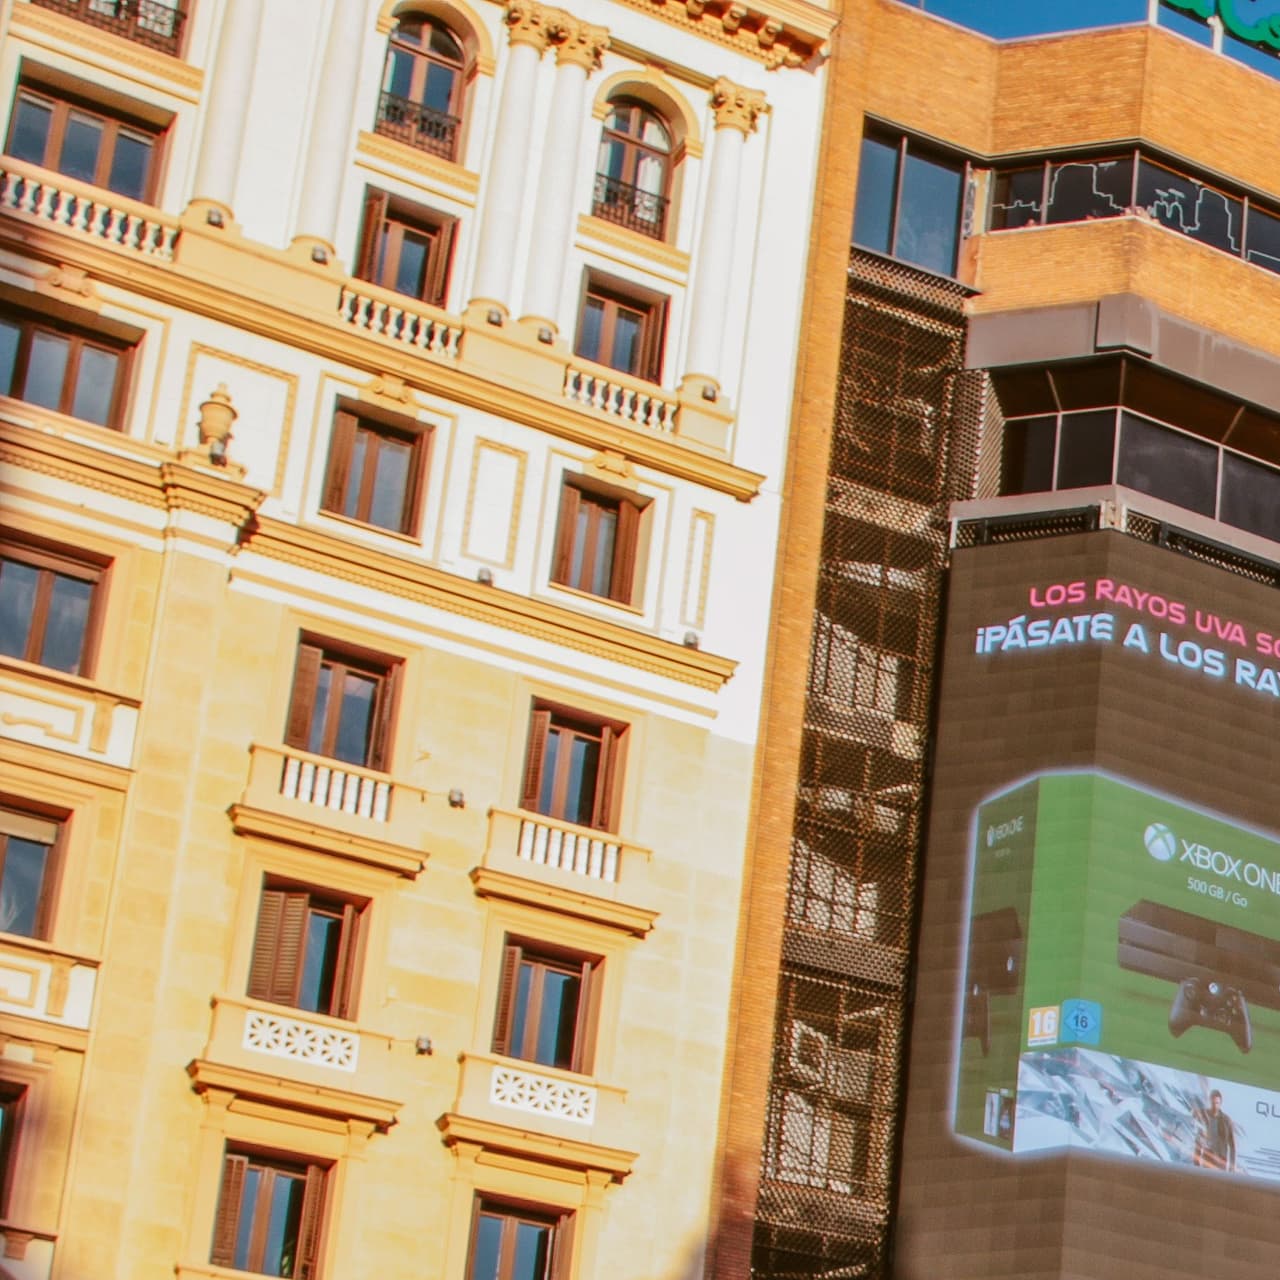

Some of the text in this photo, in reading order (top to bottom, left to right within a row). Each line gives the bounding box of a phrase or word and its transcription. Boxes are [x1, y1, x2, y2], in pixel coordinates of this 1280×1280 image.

[1029, 581, 1086, 607] LOS
[1095, 579, 1186, 625] RAYOS
[1195, 611, 1247, 646] UVA
[975, 613, 1114, 654] ¡PÁSATE
[1123, 624, 1149, 653] A
[1160, 632, 1225, 677] LOS
[1187, 877, 1208, 894] 500
[1208, 884, 1224, 900] GB
[1232, 892, 1248, 908] Go
[1032, 1010, 1057, 1035] 16
[1073, 1014, 1089, 1029] 16
